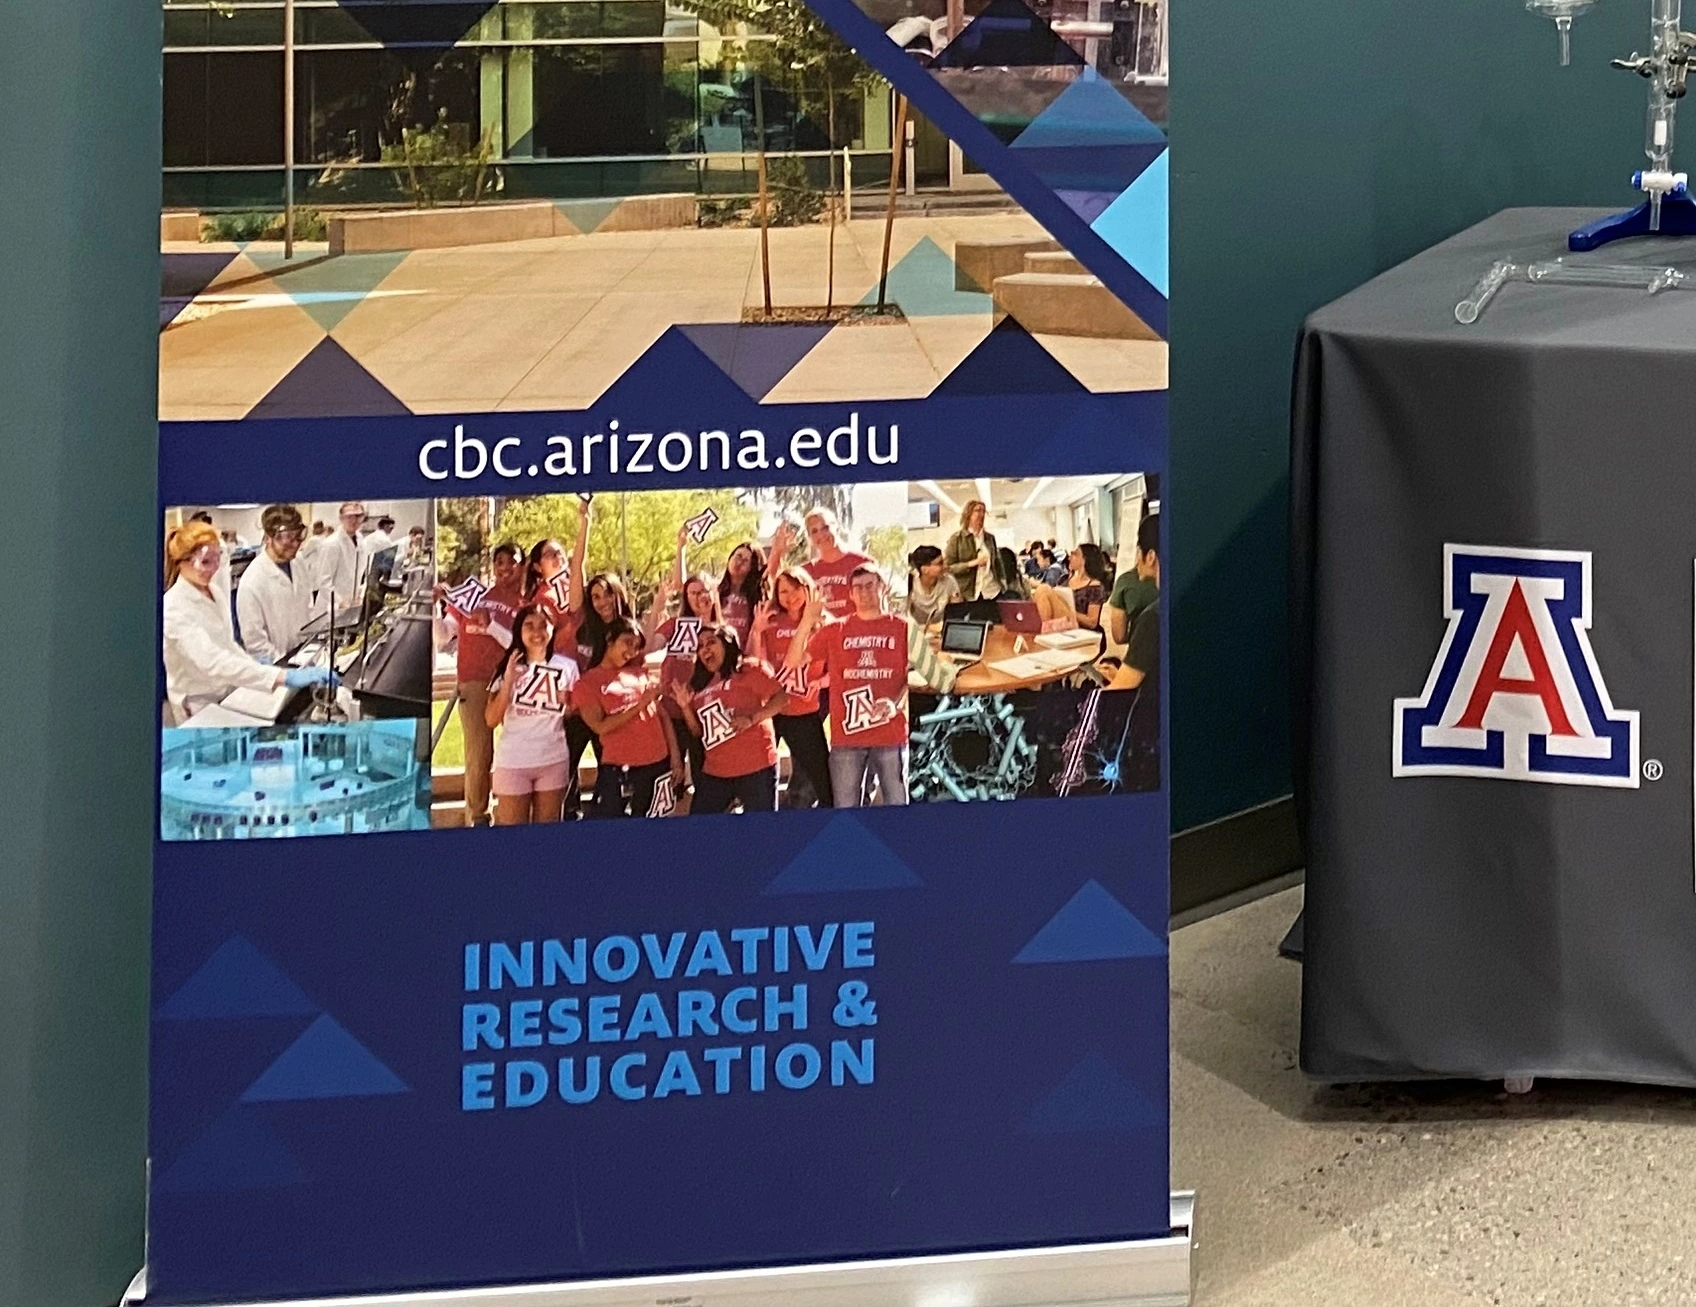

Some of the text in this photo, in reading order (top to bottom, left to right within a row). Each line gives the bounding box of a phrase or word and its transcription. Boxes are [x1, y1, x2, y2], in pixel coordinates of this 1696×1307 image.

[418, 412, 899, 480] cbc.arizona.edu
[1393, 542, 1640, 788] A
[464, 921, 876, 991] INNOVATIVE
[462, 980, 878, 1051] RESEARCH &
[462, 1039, 875, 1111] EDUCATION
